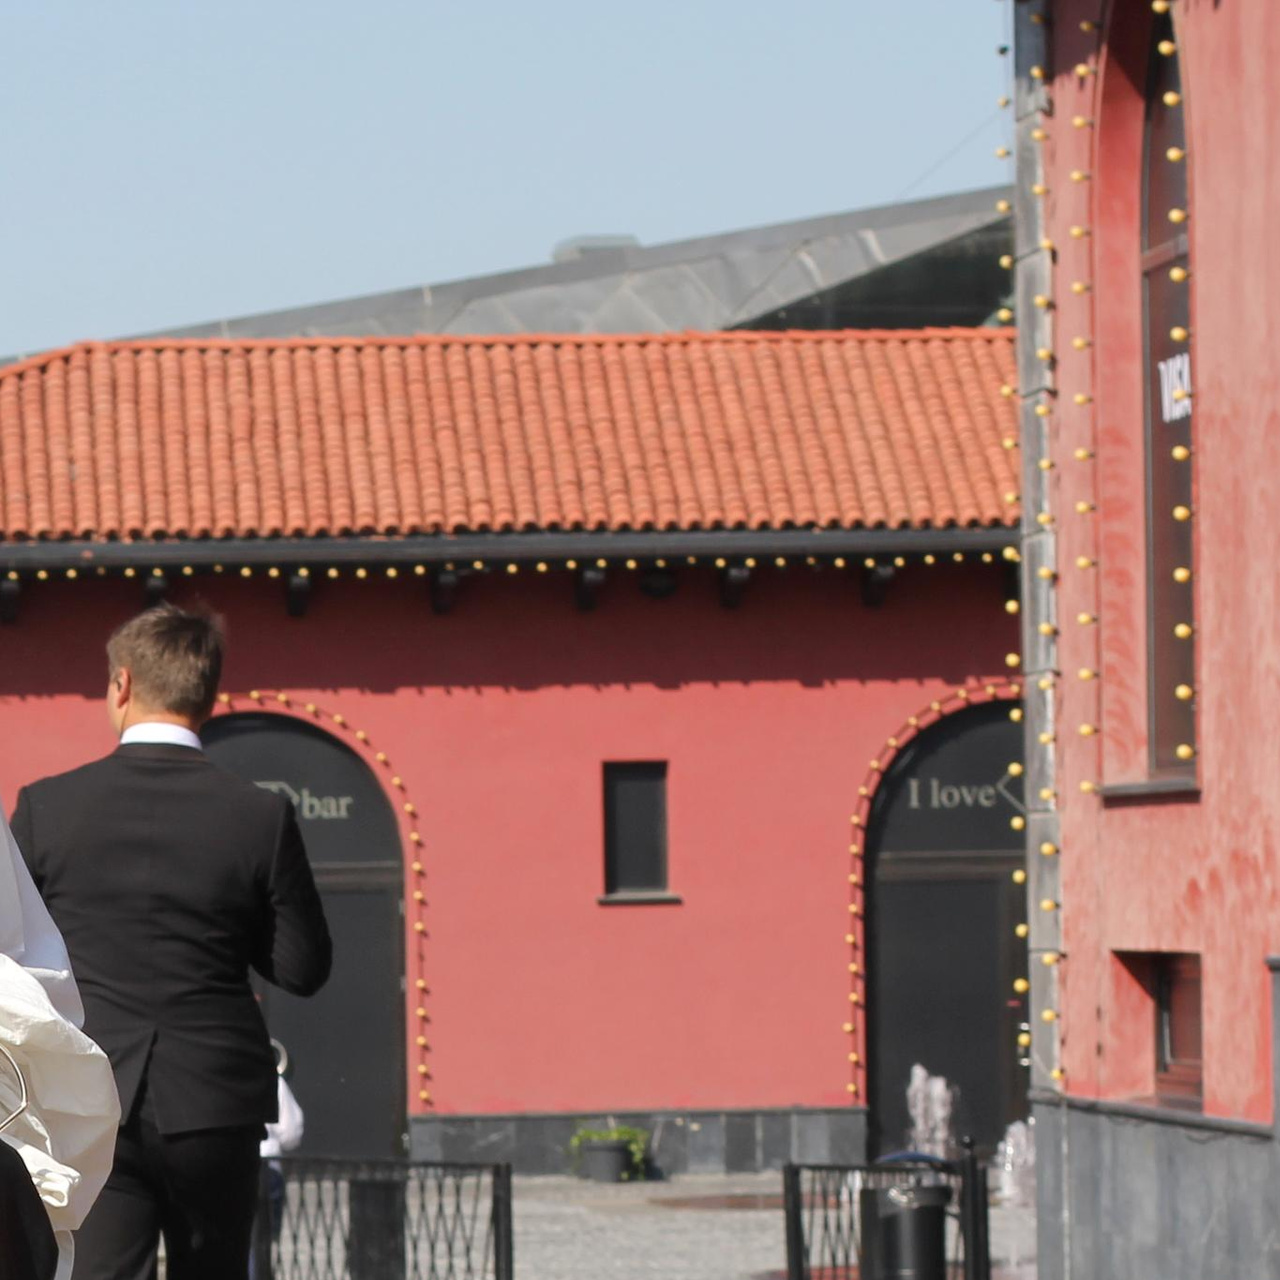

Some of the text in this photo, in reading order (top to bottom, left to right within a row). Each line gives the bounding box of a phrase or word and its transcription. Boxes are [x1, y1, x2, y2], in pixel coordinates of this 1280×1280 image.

[300, 786, 354, 820] bar
[908, 777, 997, 809] I love
